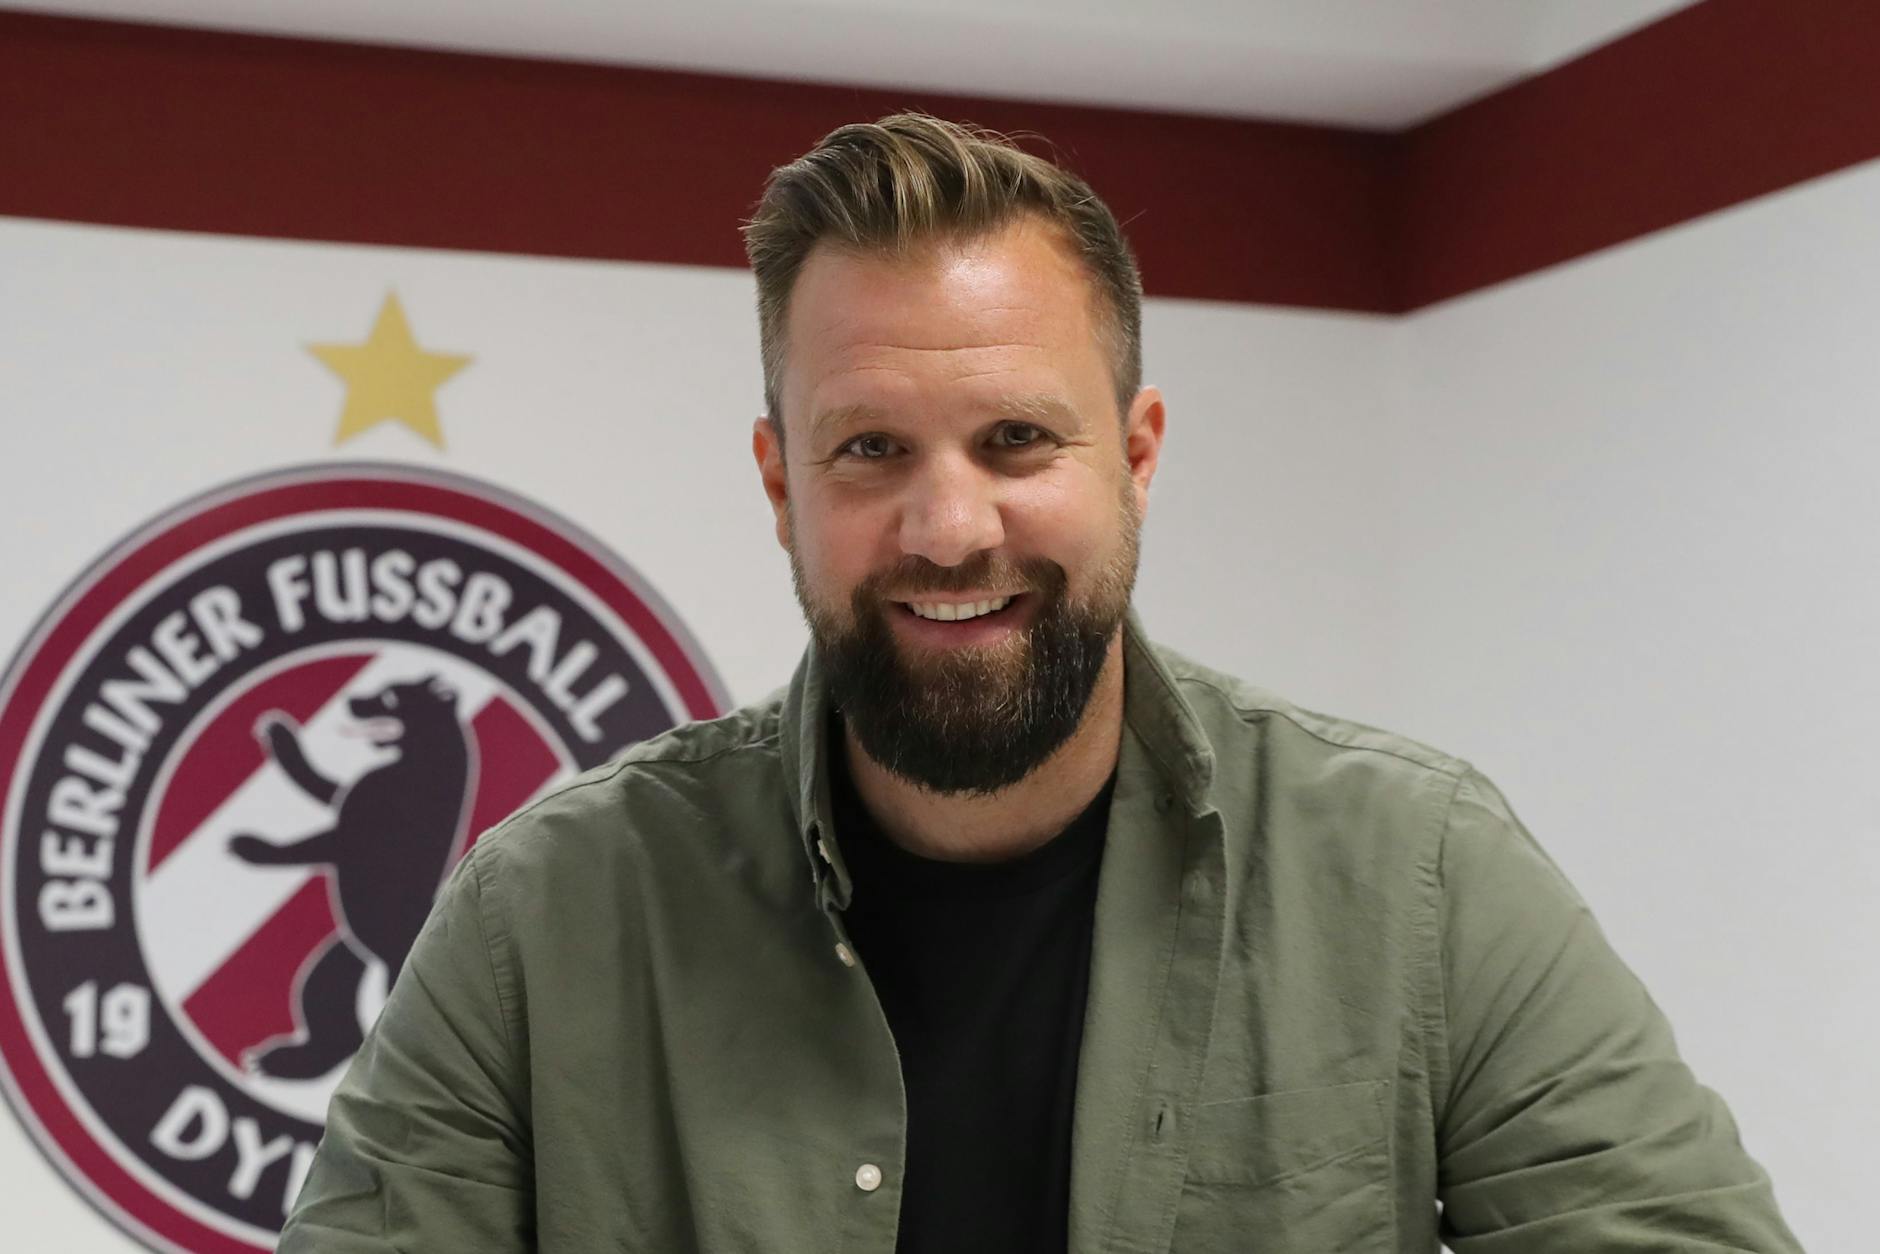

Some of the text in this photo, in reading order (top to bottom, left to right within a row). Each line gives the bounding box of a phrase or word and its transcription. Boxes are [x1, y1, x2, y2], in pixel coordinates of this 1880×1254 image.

[38, 548, 628, 931] BERLINER FUSSBALL
[63, 980, 151, 1059] 19
